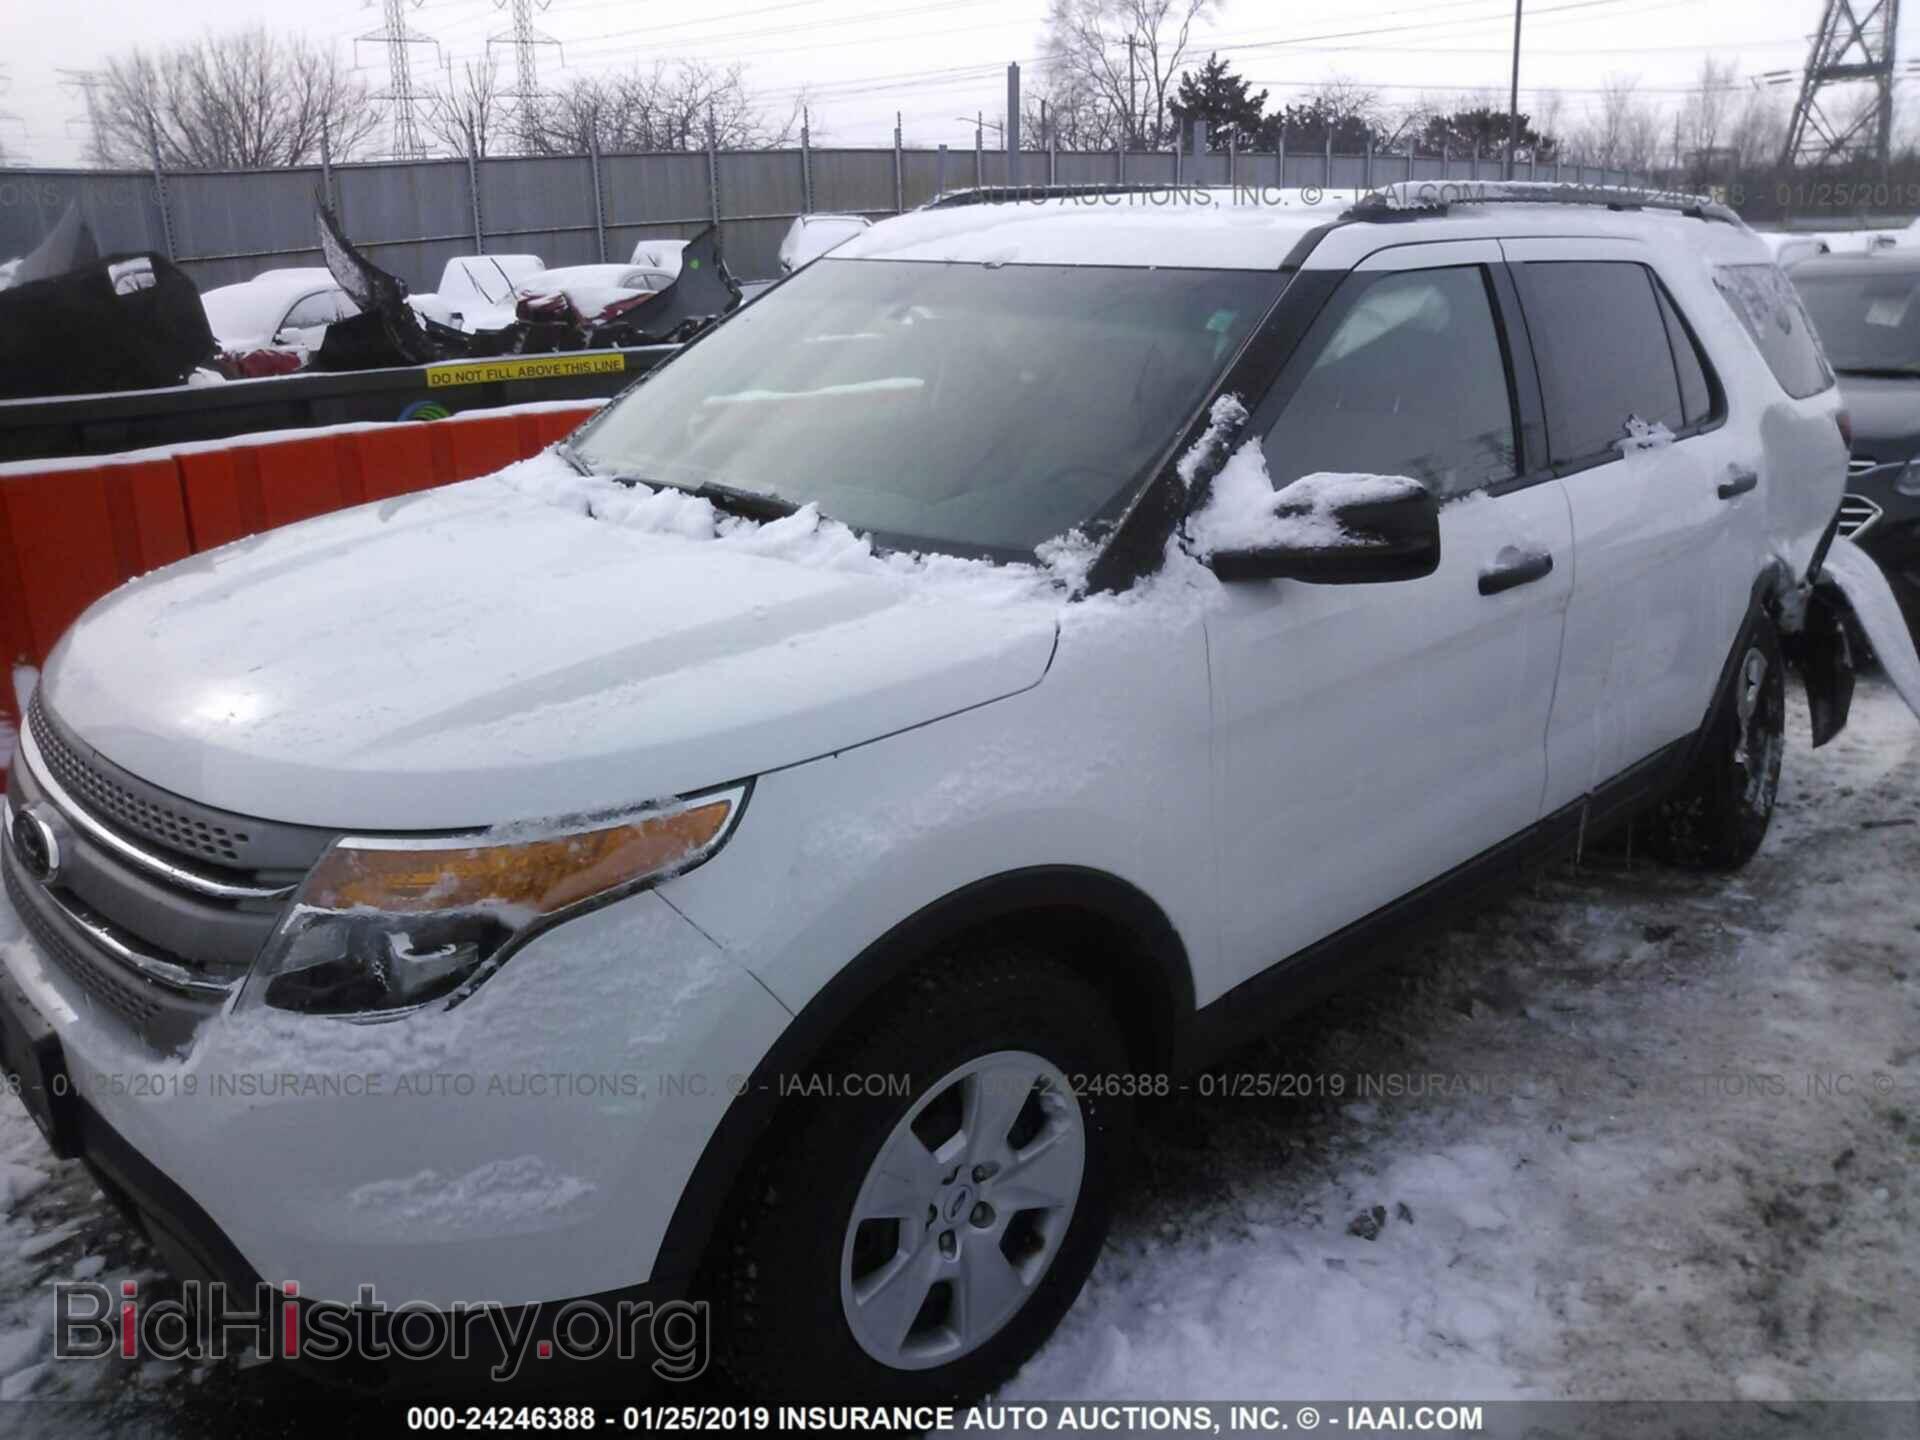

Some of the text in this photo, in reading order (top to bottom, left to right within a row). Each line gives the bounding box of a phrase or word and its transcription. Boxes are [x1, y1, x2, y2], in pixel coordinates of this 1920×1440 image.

[431, 359, 622, 385] DO NOT FILL ABOVE THIS LINE
